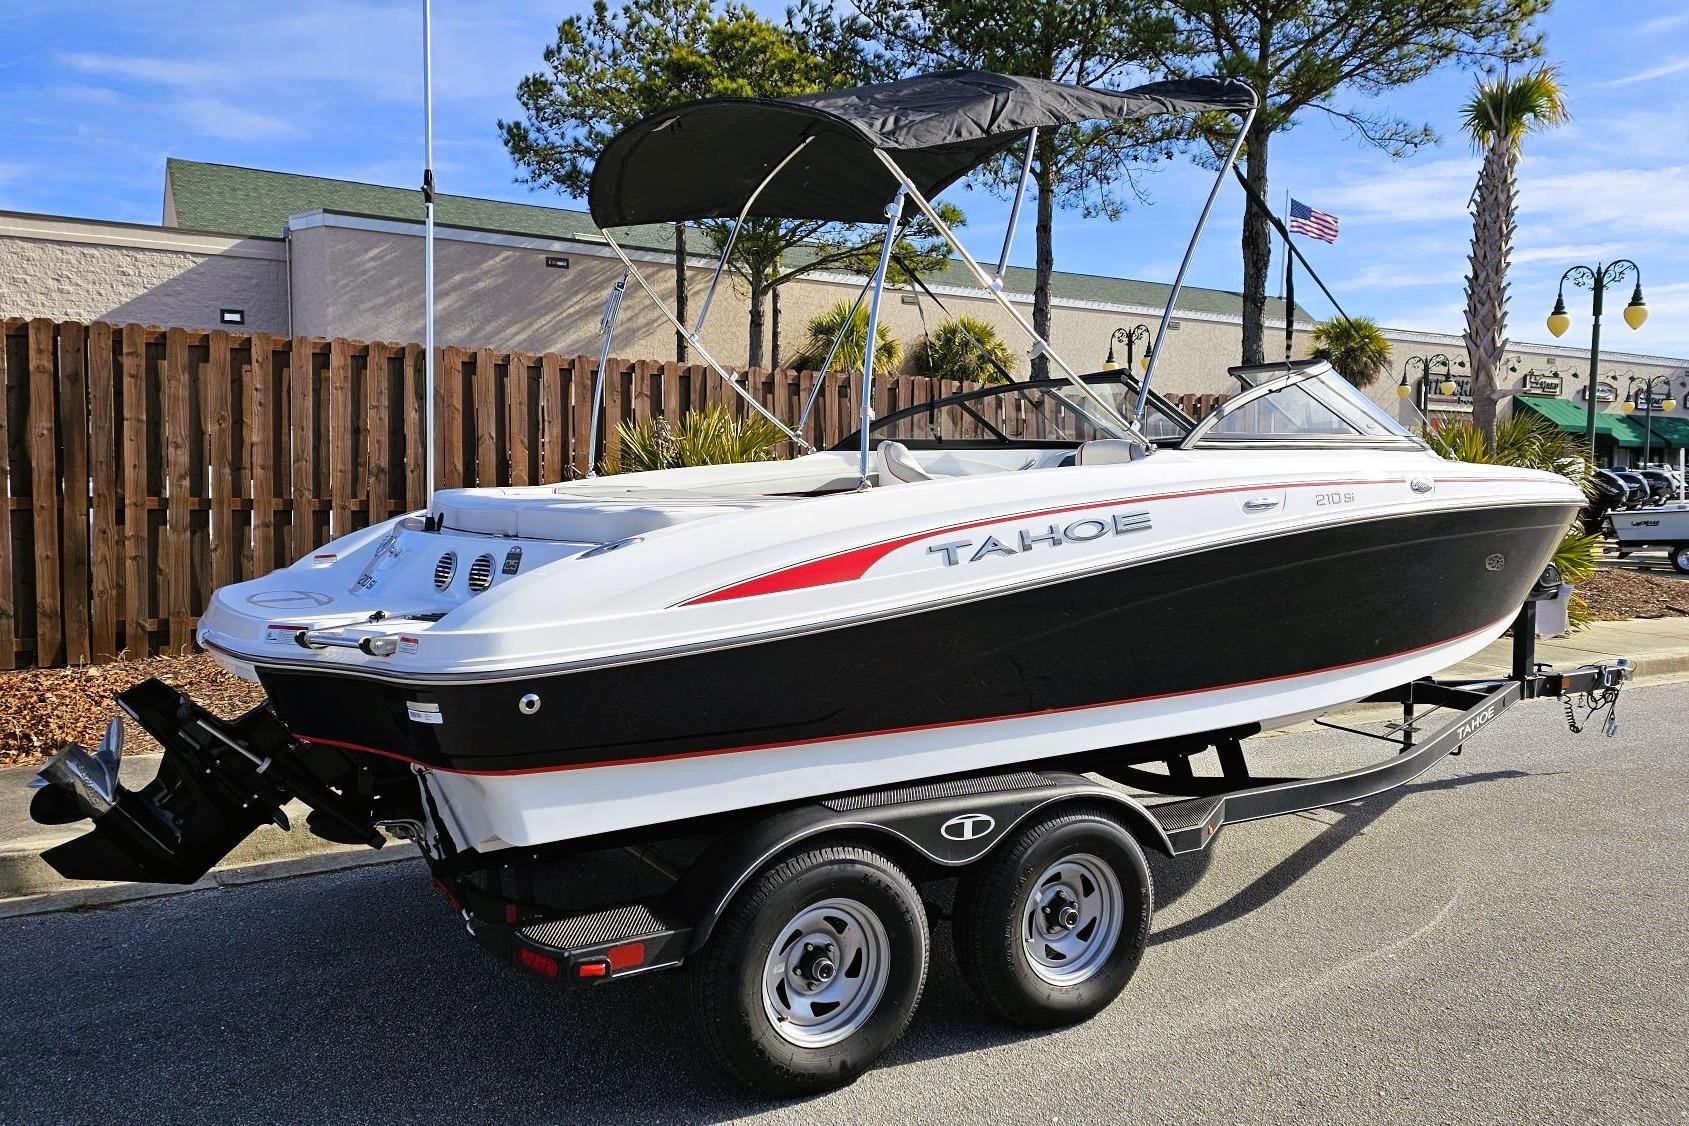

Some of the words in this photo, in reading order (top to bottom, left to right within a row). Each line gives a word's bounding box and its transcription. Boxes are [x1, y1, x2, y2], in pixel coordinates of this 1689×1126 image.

[1315, 492, 1341, 506] 210
[926, 510, 1152, 567] TAHOE
[1457, 705, 1495, 740] TAHOE
